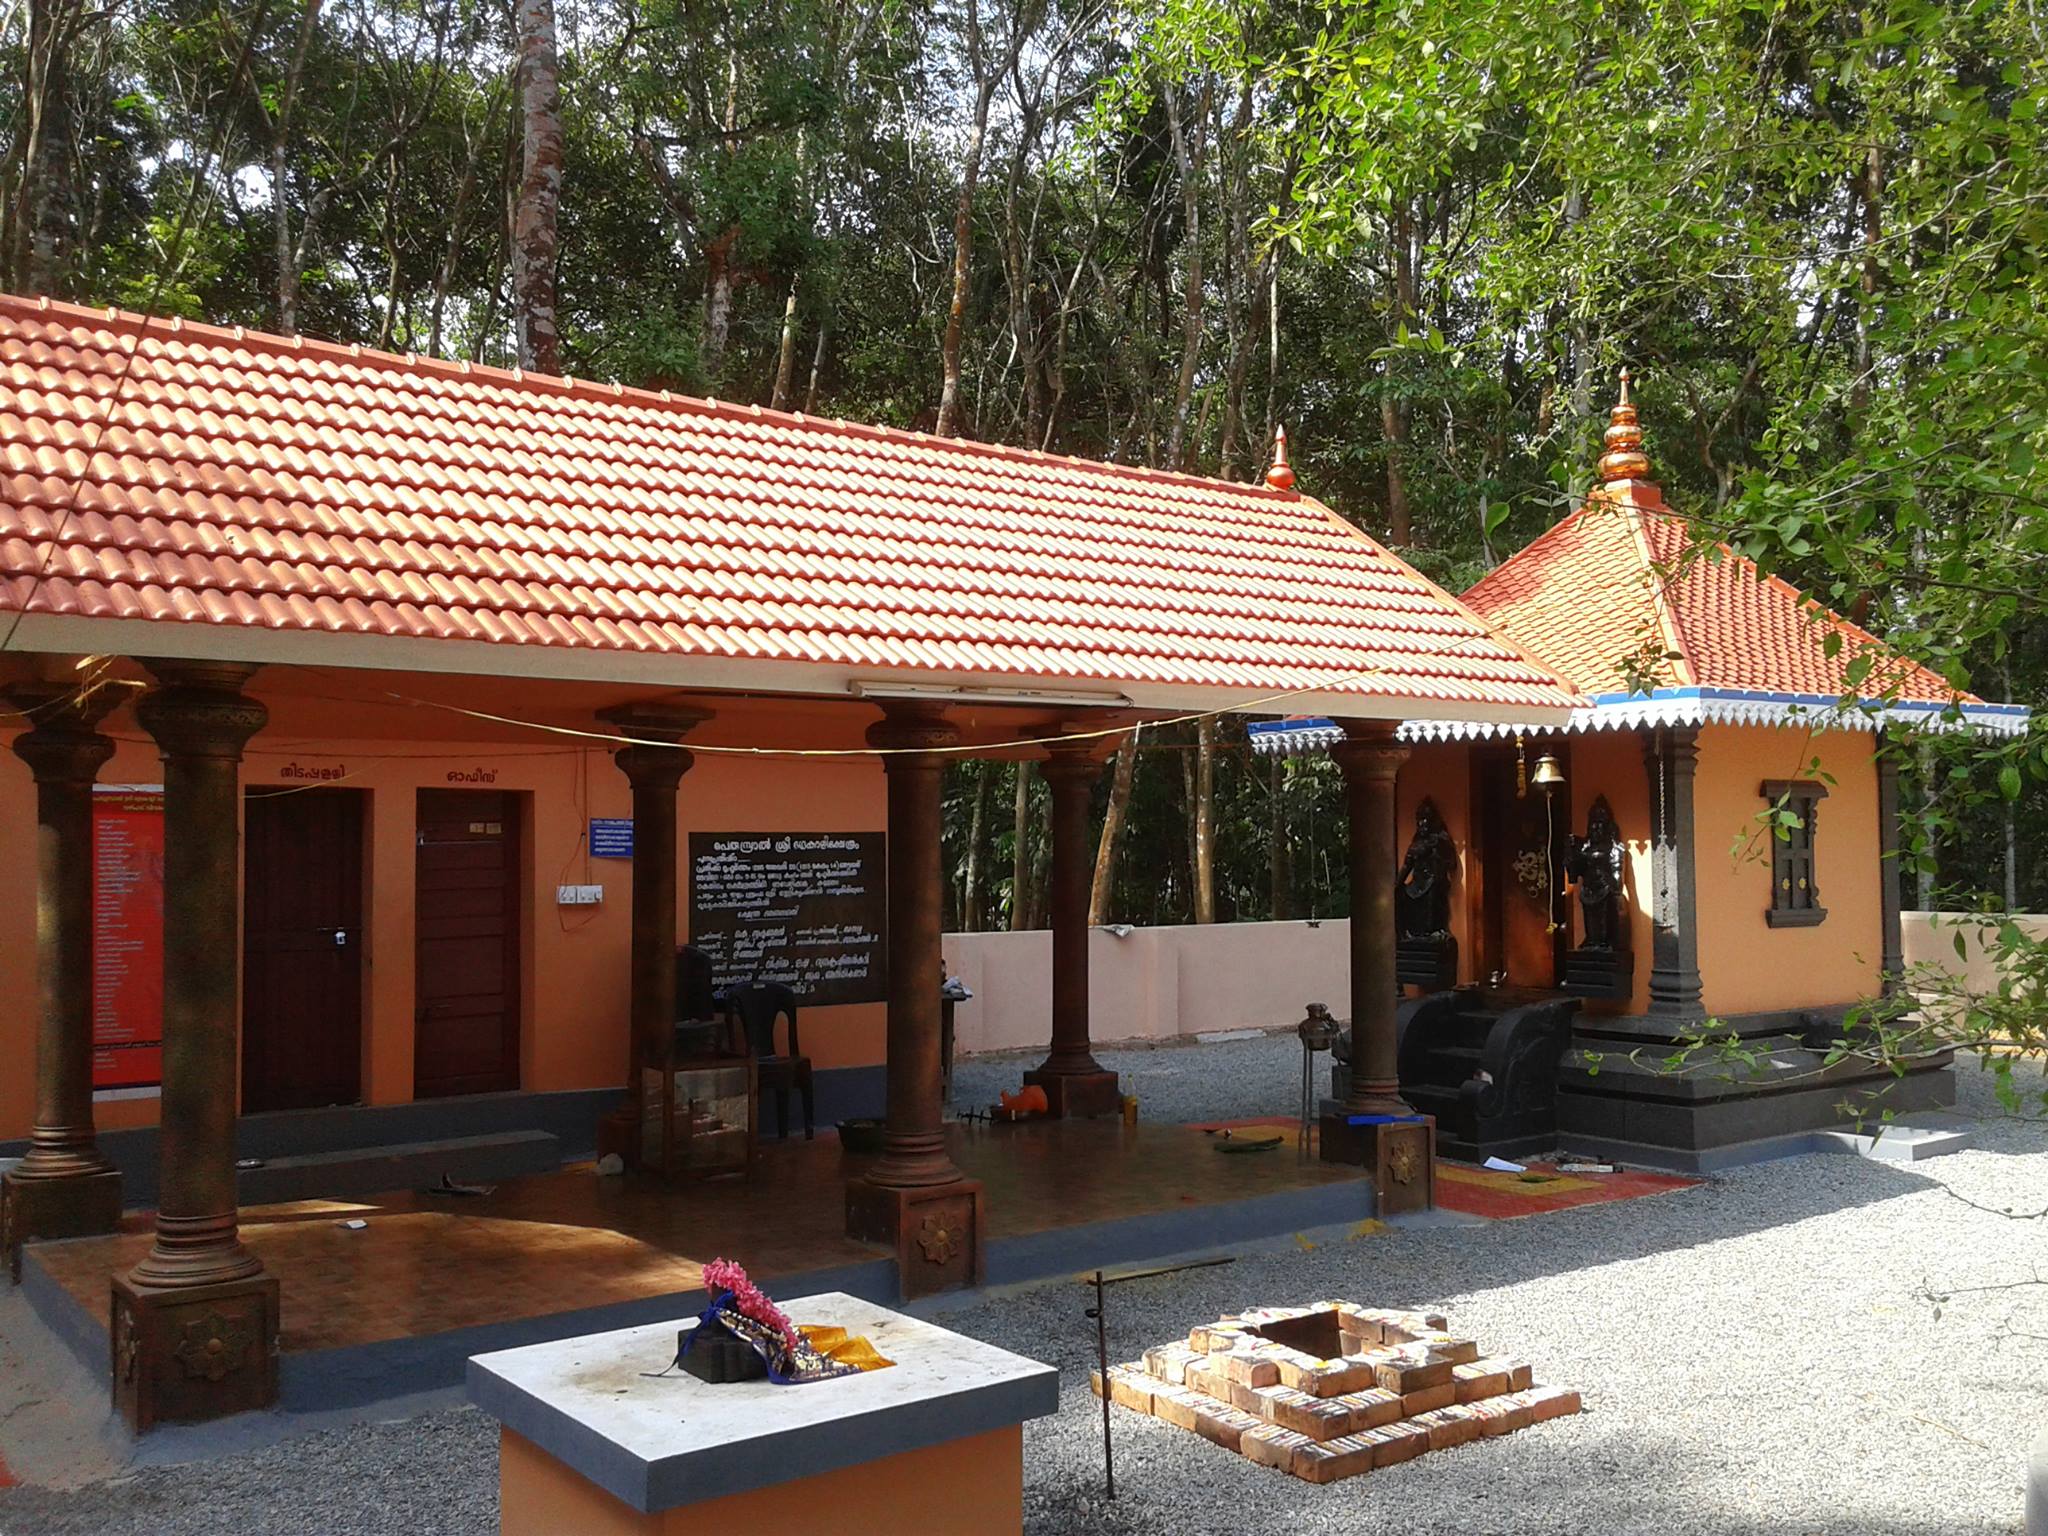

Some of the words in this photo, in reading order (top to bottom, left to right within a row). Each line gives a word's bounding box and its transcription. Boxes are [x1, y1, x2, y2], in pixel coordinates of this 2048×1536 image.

[280, 762, 345, 780] തിടപ്പള്ളി
[447, 766, 498, 783] ഓഫീസ്
[775, 835, 791, 853] ശ്രീ
